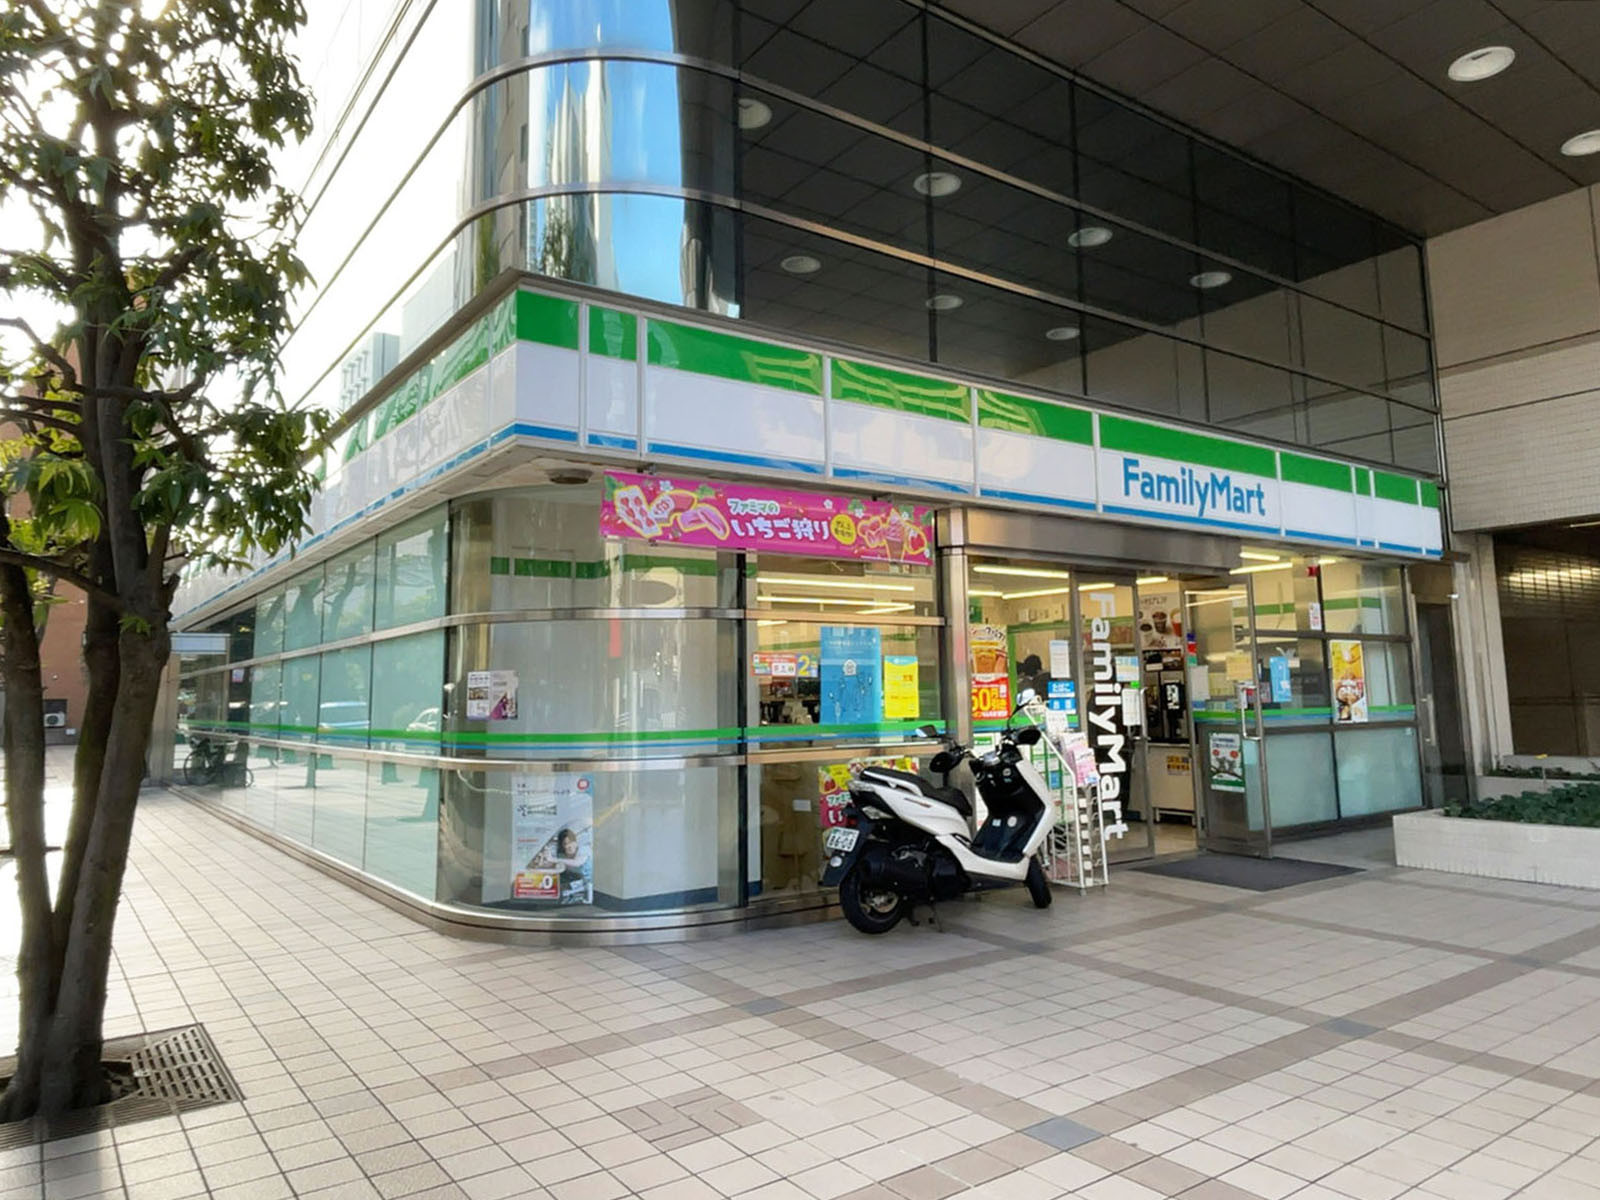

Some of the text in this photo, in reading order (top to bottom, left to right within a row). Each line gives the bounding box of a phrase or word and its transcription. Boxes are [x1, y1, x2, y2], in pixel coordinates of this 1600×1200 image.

[728, 499, 780, 515] ファミマの
[1123, 457, 1265, 517] FamilyMart
[731, 517, 829, 540] いちご狩り
[1088, 592, 1129, 841] FamilyMart
